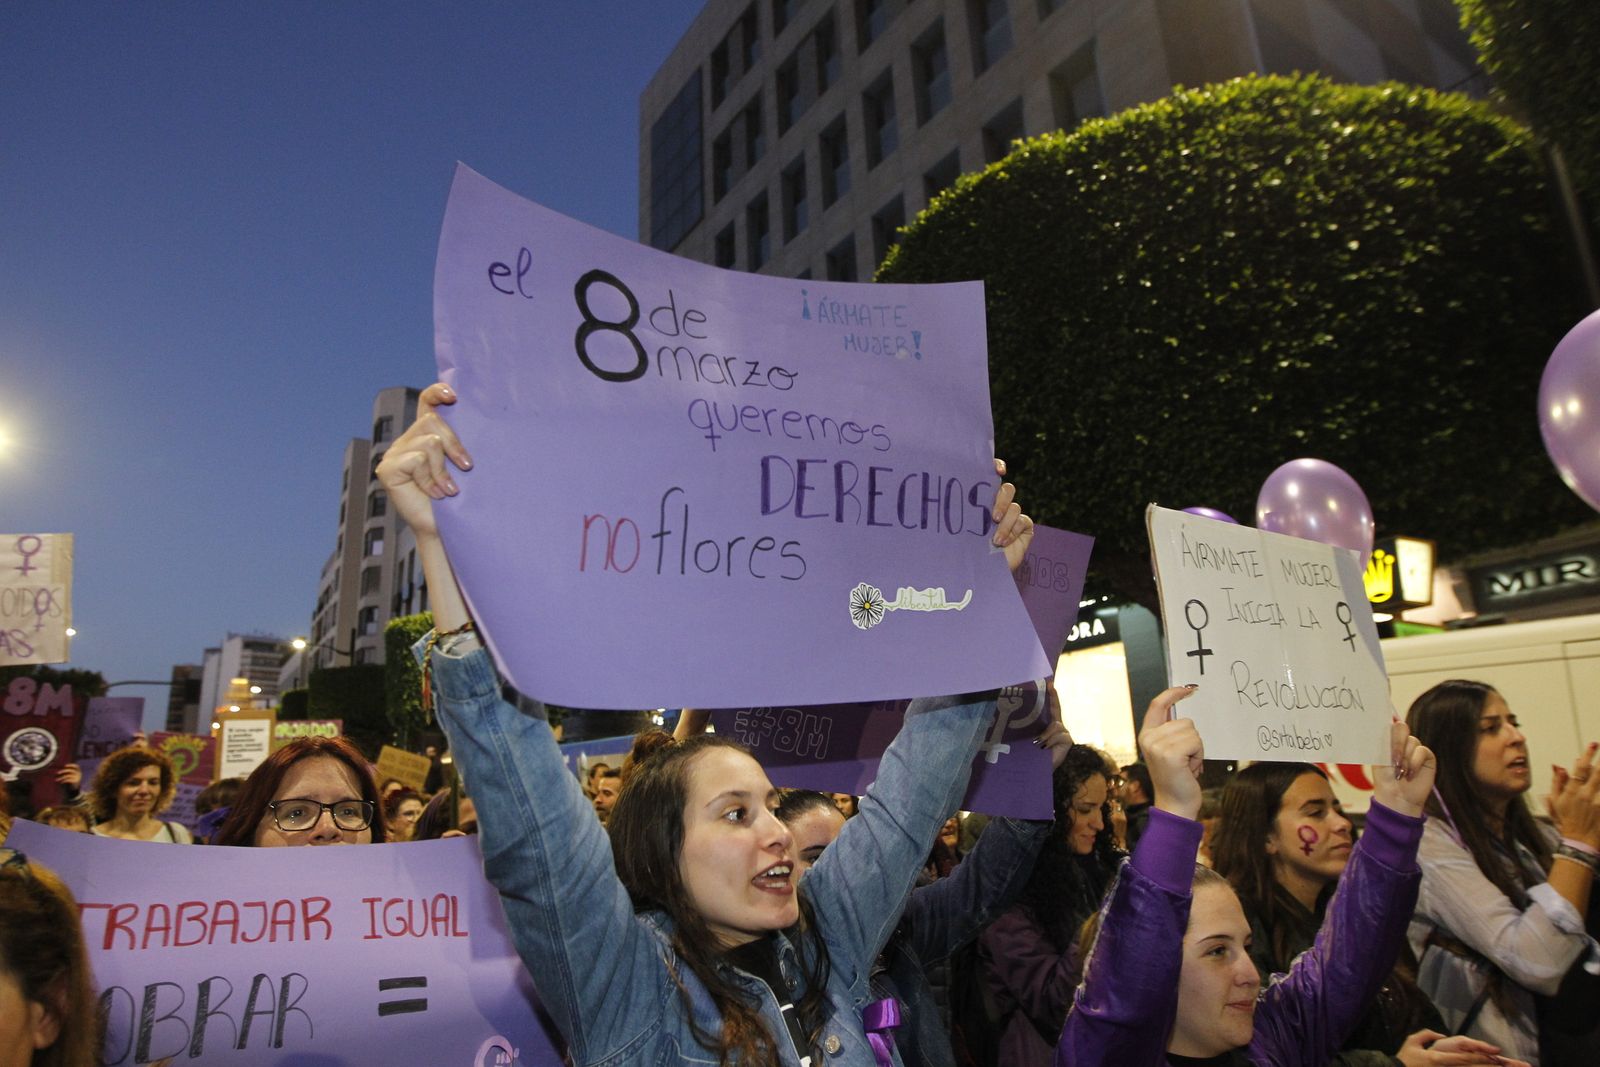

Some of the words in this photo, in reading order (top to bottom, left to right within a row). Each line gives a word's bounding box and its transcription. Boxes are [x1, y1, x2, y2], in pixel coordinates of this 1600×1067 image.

[488, 247, 533, 298] el
[574, 269, 648, 382] 8
[650, 289, 707, 338] de
[657, 346, 798, 390] marzo
[688, 398, 892, 451] queremos
[760, 455, 993, 537] DERECHOS
[580, 513, 640, 573] no
[652, 487, 806, 580] flores
[898, 587, 945, 610] libertad
[1300, 606, 1322, 629] LA
[3, 676, 75, 716] 8M
[734, 707, 833, 760] #8M
[363, 893, 469, 940] IGUAL
